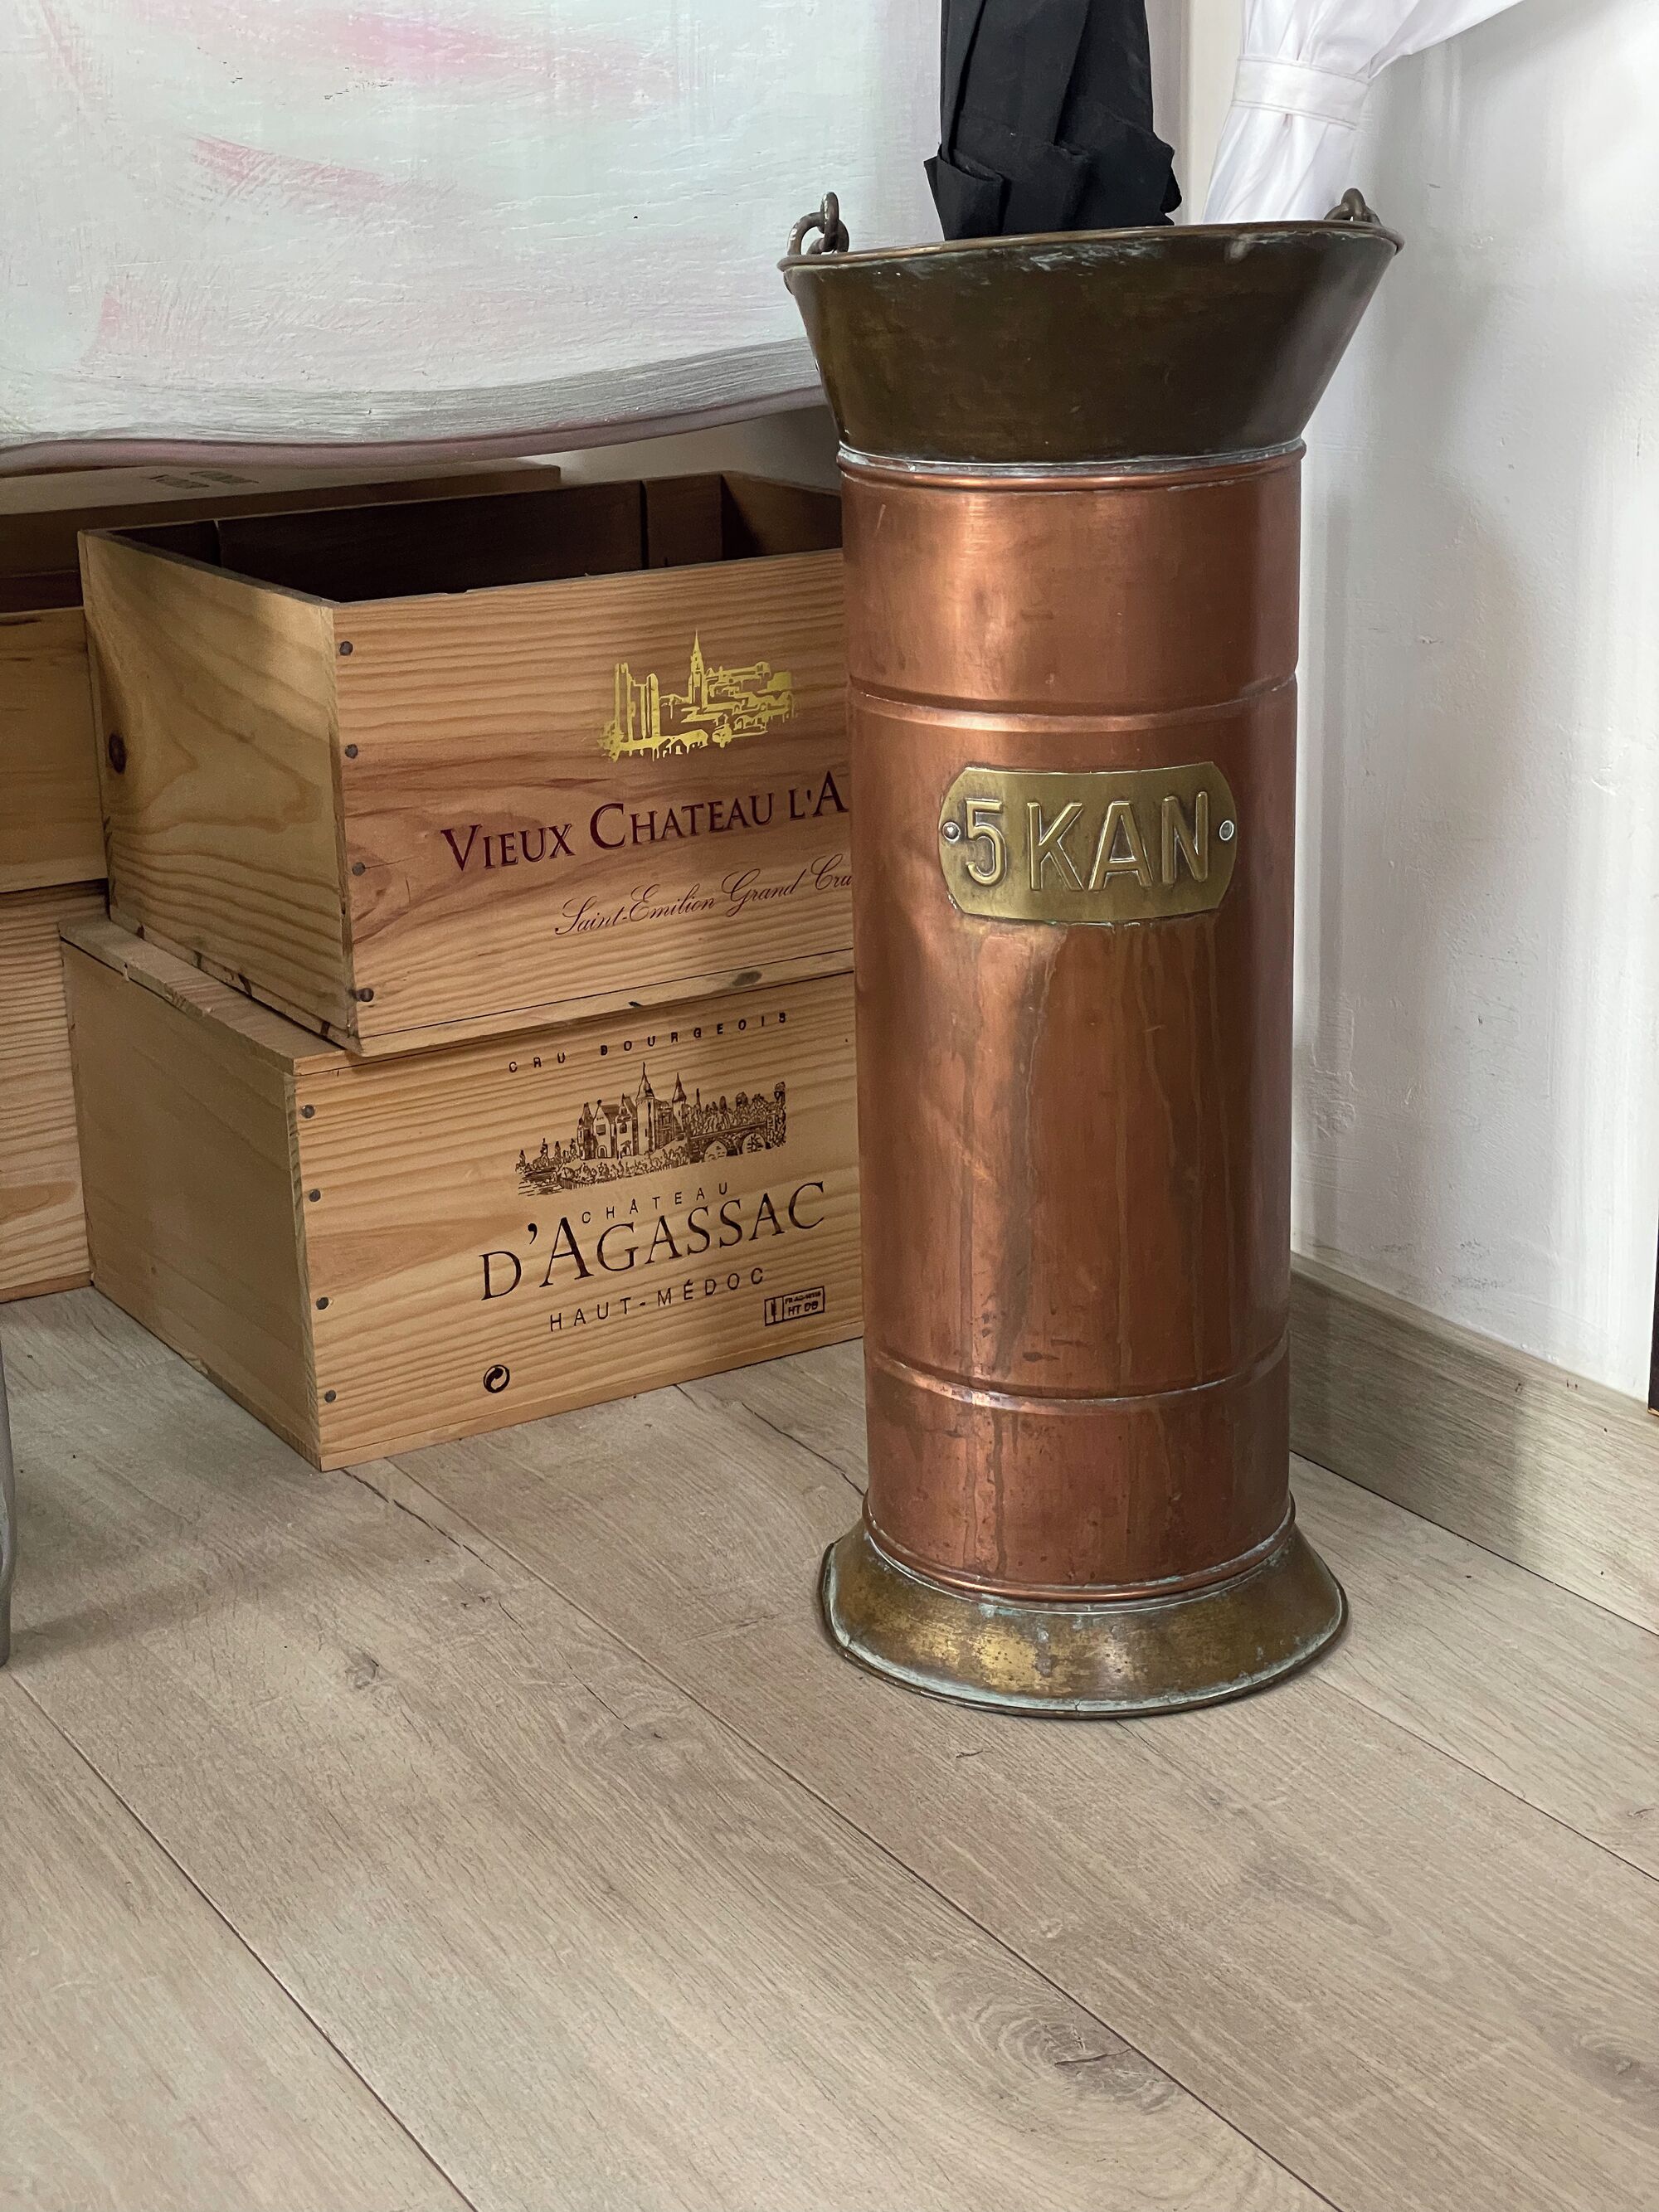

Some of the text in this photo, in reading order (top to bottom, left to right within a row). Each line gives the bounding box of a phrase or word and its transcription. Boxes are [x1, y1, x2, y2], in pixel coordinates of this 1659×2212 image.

[440, 823, 576, 872] VIEUX
[589, 793, 775, 851] CHATEAU
[964, 790, 1209, 892] 5 KAN
[554, 883, 716, 936] Saint-Emilion
[721, 868, 807, 917] Grand
[508, 1013, 786, 1073] CRU BOURGEOIS
[478, 1181, 825, 1301] D'AGASSAC
[550, 1267, 766, 1332] HAUT-MÉDOC
[788, 1305, 802, 1316] HT
